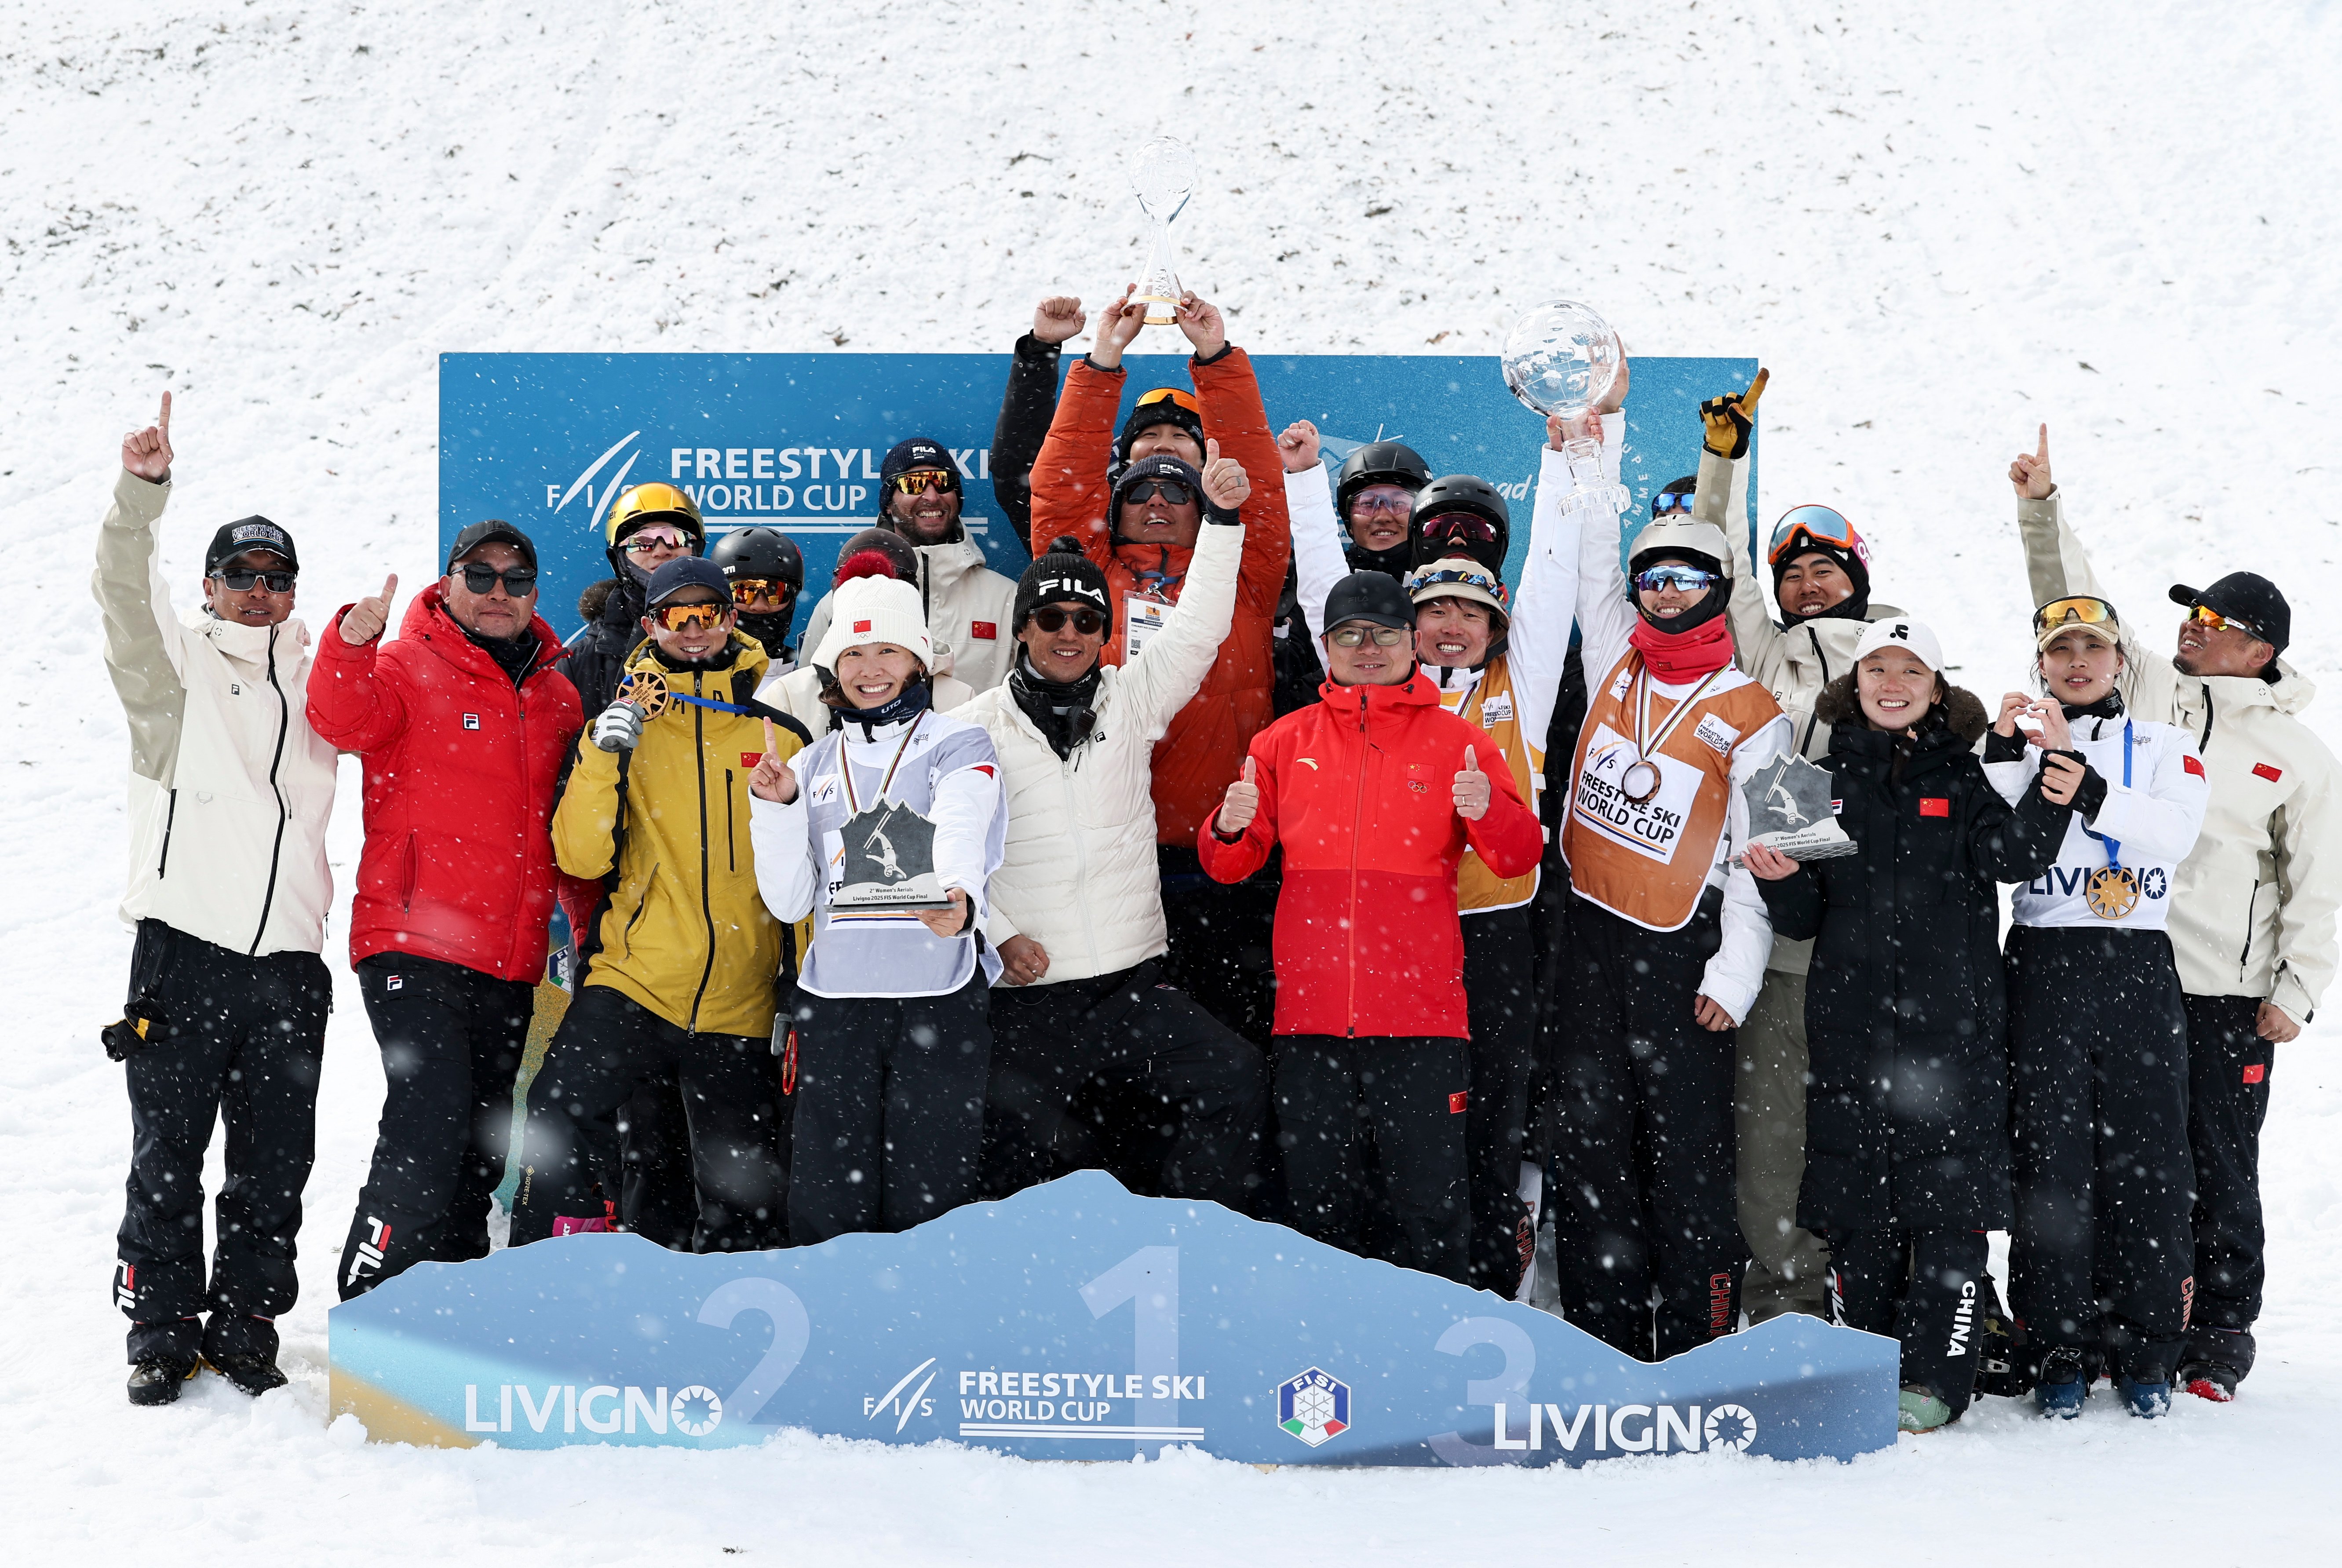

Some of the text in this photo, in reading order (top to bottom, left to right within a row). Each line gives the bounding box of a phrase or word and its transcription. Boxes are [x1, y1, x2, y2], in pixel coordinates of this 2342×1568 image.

[671, 448, 989, 479] FREESTYL KI
[1159, 464, 1184, 474] FILA
[803, 485, 867, 511] CUP
[232, 524, 284, 538] FREESTYLE SKI
[232, 530, 284, 543] WORLD CUP
[722, 565, 736, 575] ern
[1038, 578, 1106, 606] FILA
[631, 683, 643, 696] LIVIGNO
[1697, 728, 1729, 752] WORLD CUP
[1700, 724, 1724, 743] FREESTYLE
[1588, 747, 1616, 769] FIS
[813, 788, 834, 798] FIS
[1577, 784, 1674, 843] WORLD CUP
[1651, 806, 1681, 828] SKI
[2029, 866, 2167, 900] LIVINO
[556, 950, 569, 960] FI
[522, 1176, 531, 1206] GORE-TEX
[117, 1258, 136, 1314] FIL
[1946, 1280, 1977, 1357] CHINA
[697, 1277, 812, 1448] 2
[1078, 1245, 1179, 1458] 1
[960, 1371, 1205, 1400] FREESTYLE SKI
[1292, 1374, 1337, 1393] FISI
[1427, 1316, 1536, 1467] 3
[465, 1384, 722, 1437] LIVIGNO
[863, 1397, 934, 1418] FIS
[960, 1399, 1111, 1422] WORLD CUP
[1494, 1402, 1757, 1452] LIVIGNO
